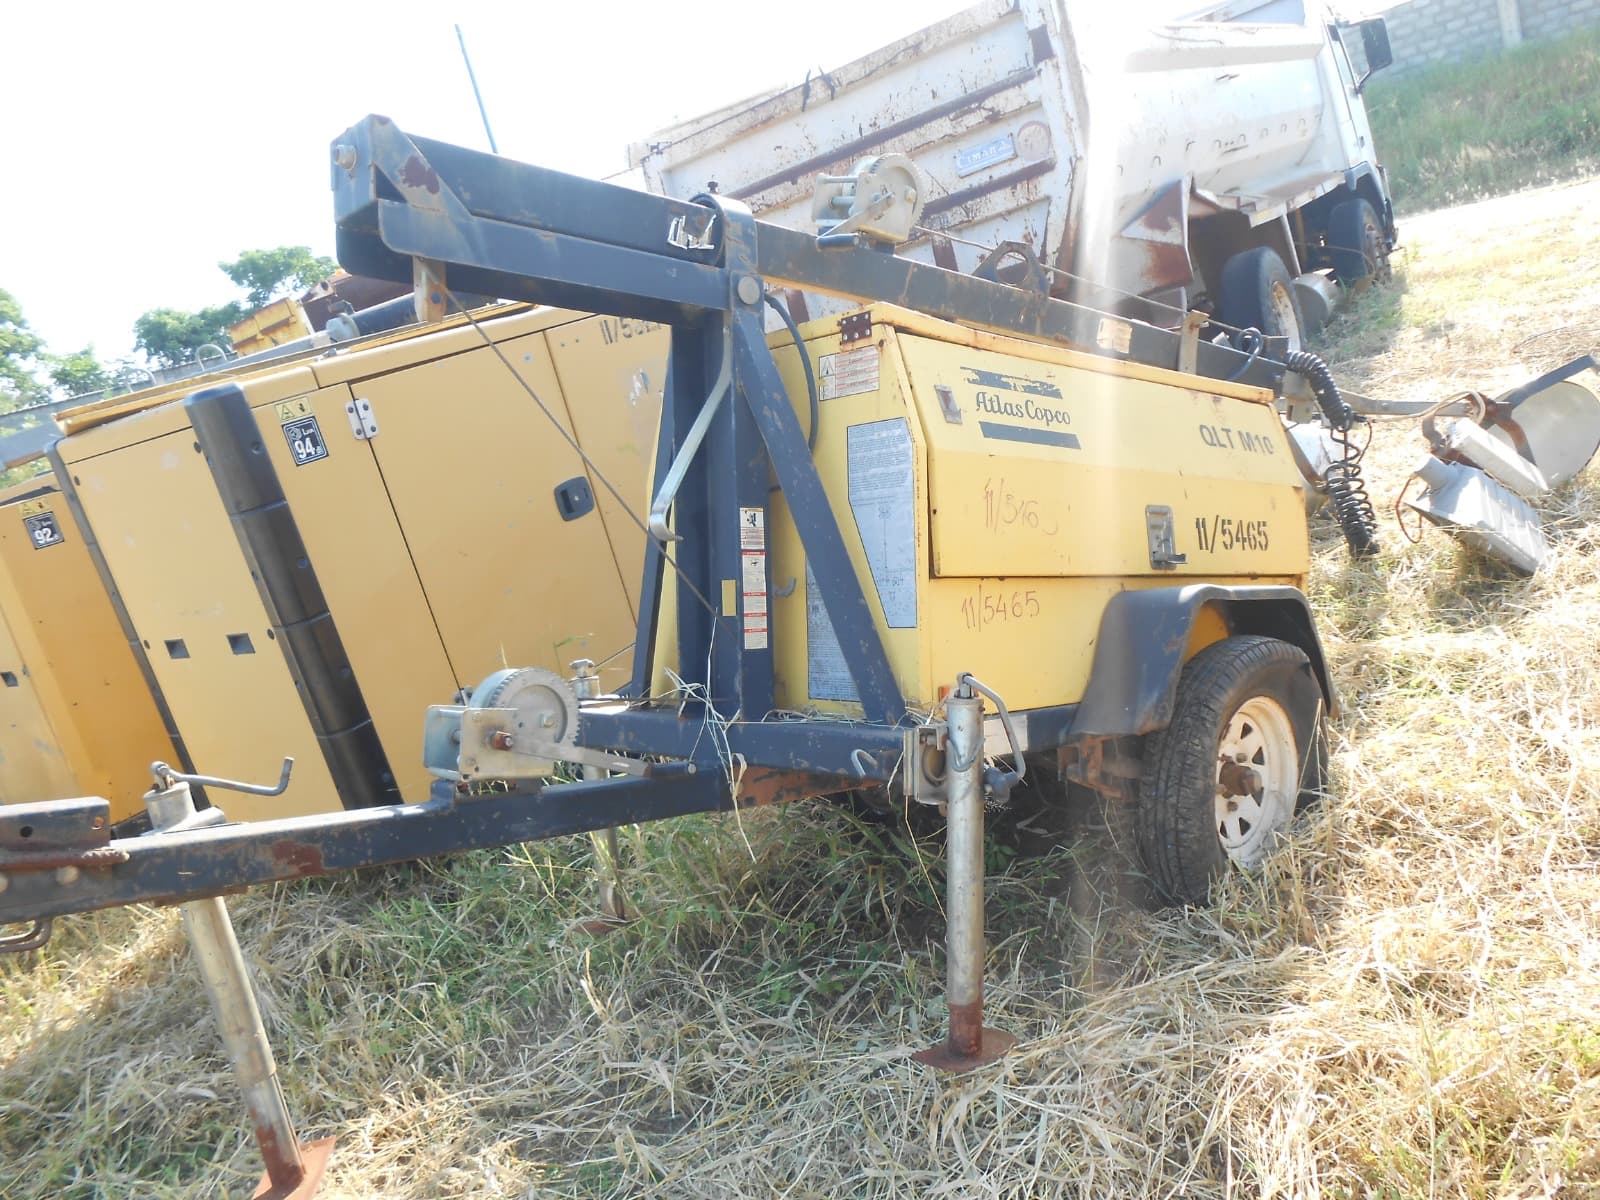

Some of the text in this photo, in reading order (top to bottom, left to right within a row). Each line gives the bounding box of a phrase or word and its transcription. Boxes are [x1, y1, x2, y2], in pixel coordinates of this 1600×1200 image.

[976, 391, 1071, 426] Atlas Copco
[294, 437, 316, 459] 94
[1199, 424, 1274, 455] QLT M10
[34, 527, 54, 544] 92
[1195, 514, 1269, 554] 11/5465
[961, 583, 1040, 632] 11/5465
